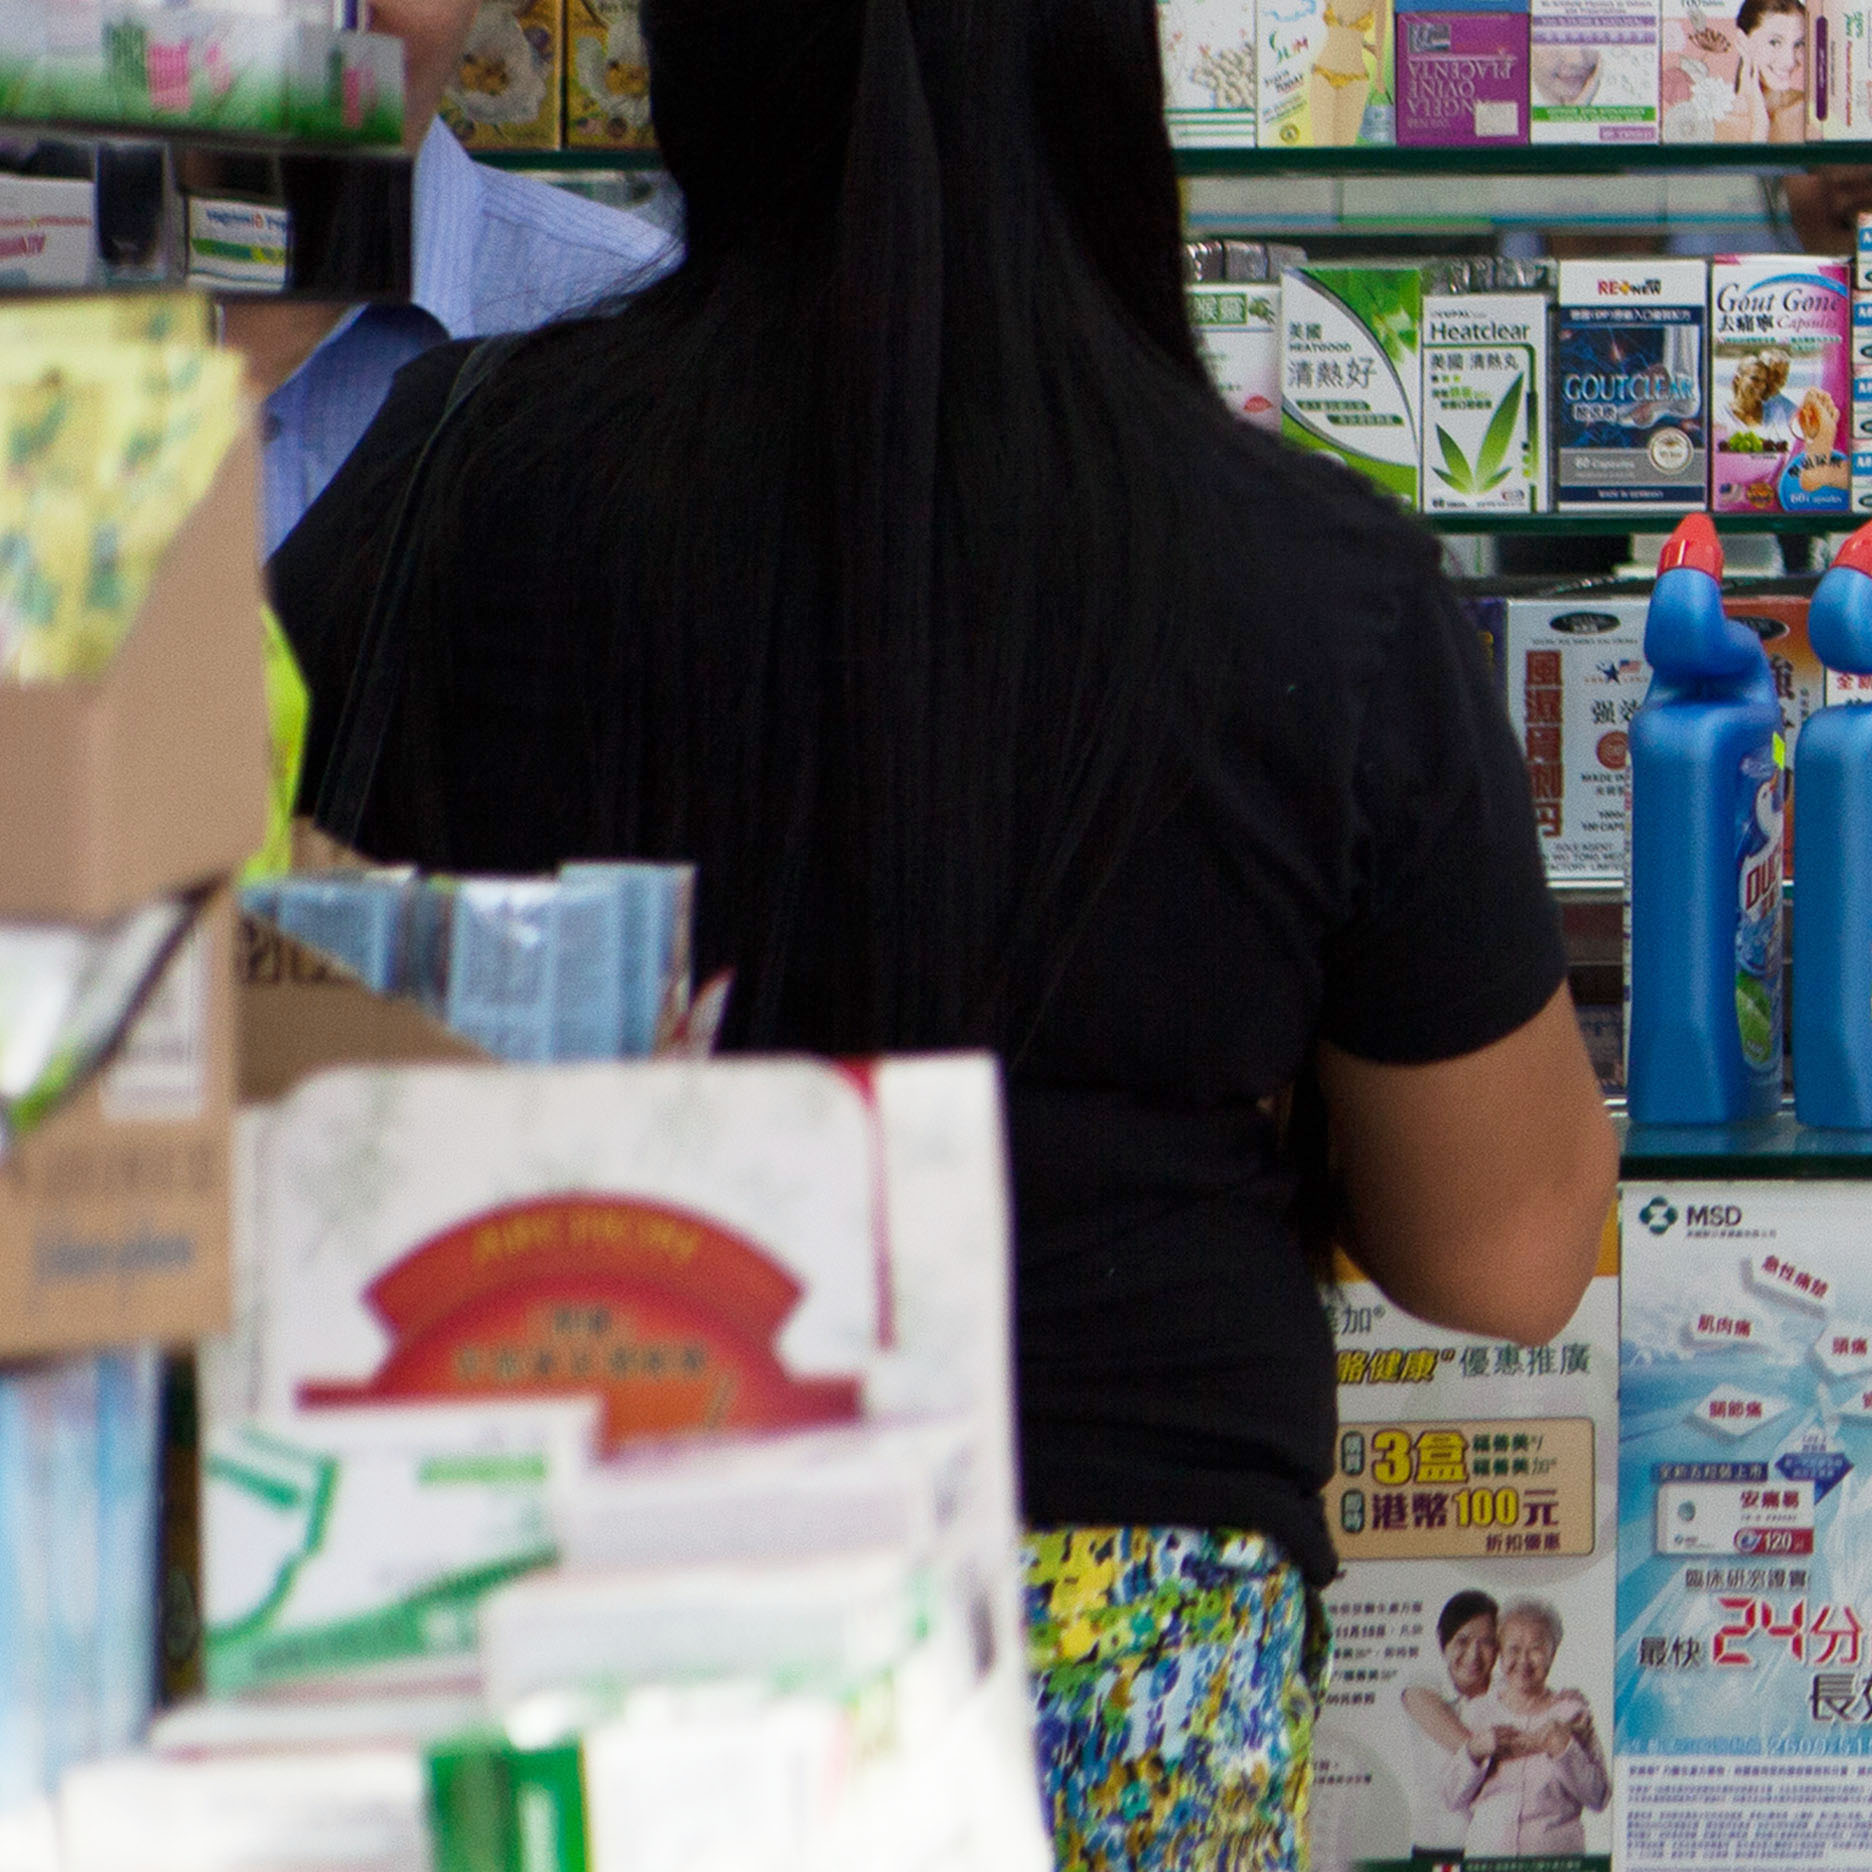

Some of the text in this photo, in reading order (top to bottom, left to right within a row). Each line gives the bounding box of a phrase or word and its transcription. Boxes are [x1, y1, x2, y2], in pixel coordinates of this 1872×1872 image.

[1718, 283, 1841, 318] Gout Gone
[1430, 322, 1530, 341] Heatclear
[1687, 1205, 1742, 1227] MSD
[1373, 1489, 1559, 1527] 港幣100元
